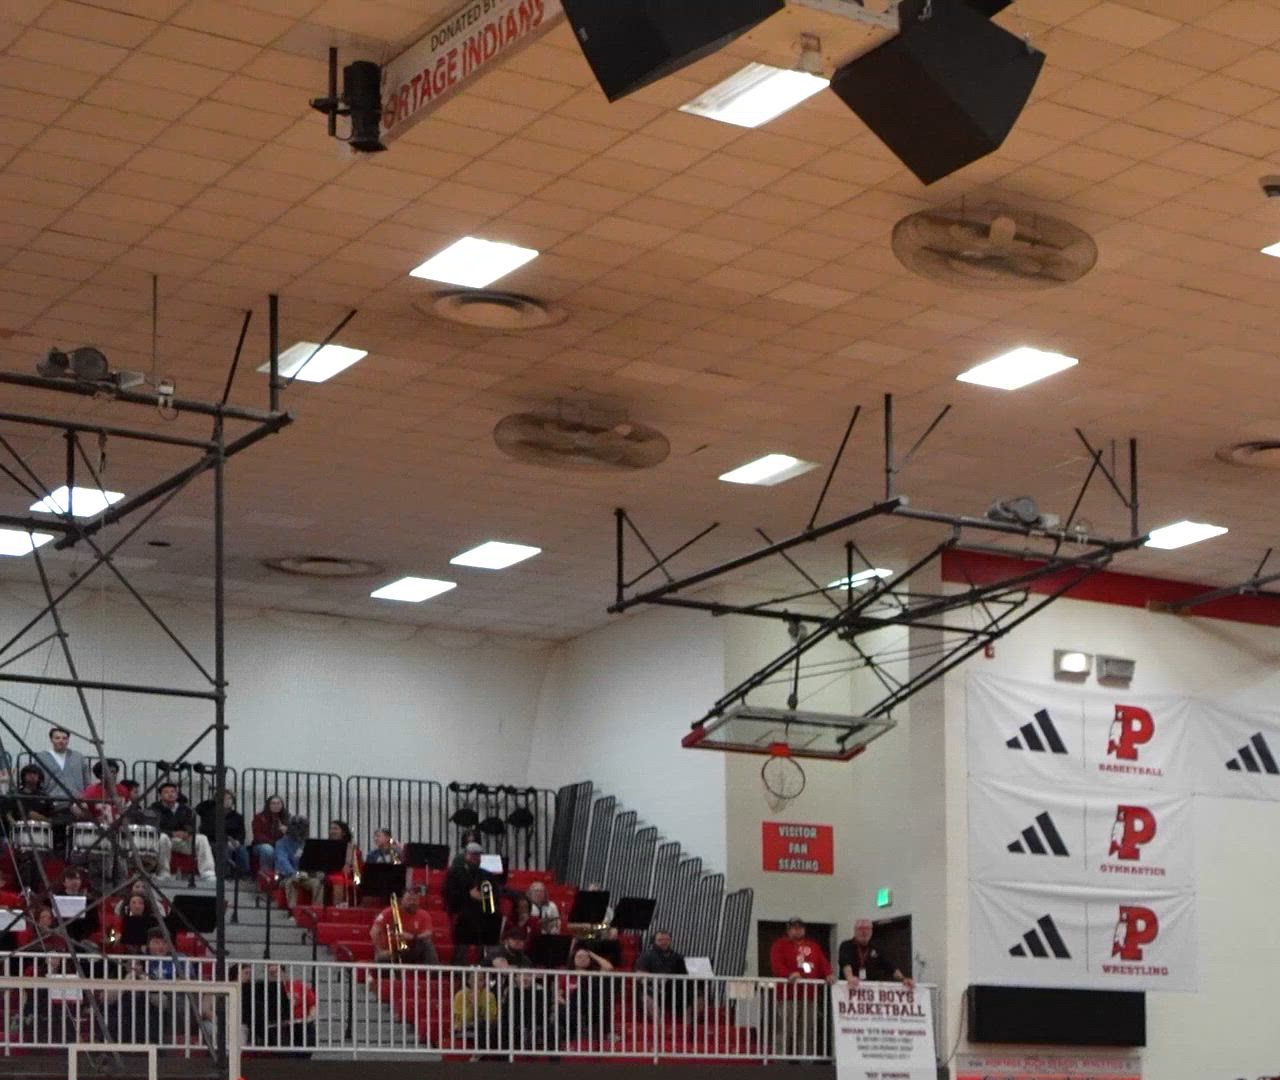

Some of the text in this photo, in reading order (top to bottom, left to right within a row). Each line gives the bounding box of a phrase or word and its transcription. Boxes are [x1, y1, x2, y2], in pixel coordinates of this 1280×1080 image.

[431, 3, 481, 52] DONATED
[381, 0, 545, 130] ORTAGE INDIANS
[1107, 704, 1155, 761] P
[1099, 763, 1164, 777] BASKETBALL
[778, 826, 817, 839] VISITOR
[1109, 805, 1156, 860] P
[788, 842, 808, 855] FAN
[778, 858, 819, 872] SEATING
[1100, 864, 1167, 877] GYMNASTICS
[1112, 906, 1159, 961] P
[1102, 964, 1169, 977] WRESTLING
[848, 988, 915, 1003] PHS BOYS
[838, 1002, 927, 1018] BASKETBALL
